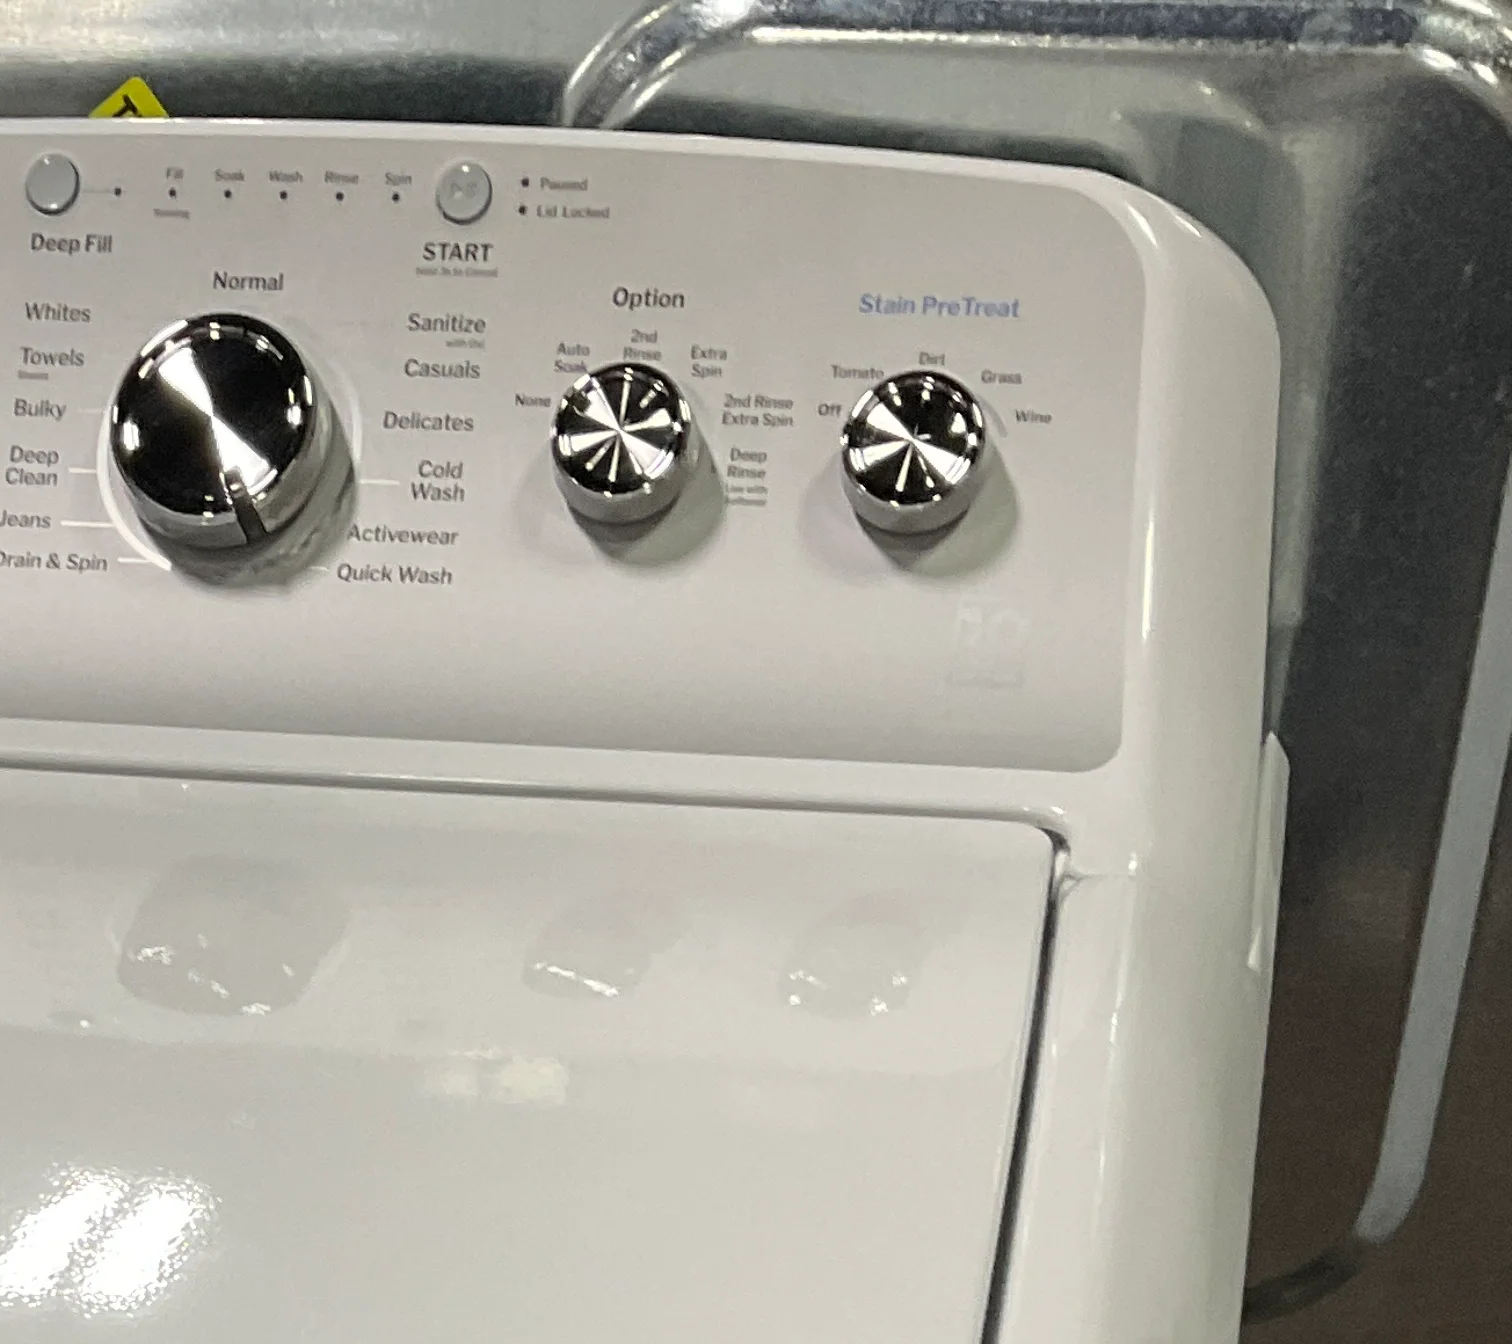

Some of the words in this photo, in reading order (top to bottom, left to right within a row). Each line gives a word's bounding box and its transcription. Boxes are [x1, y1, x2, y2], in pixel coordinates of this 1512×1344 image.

[30, 232, 81, 255] Deep
[85, 234, 113, 254] Fill
[422, 241, 494, 262] START
[212, 271, 285, 291] Normal
[611, 286, 686, 311] Option
[858, 293, 916, 315] Stain
[24, 301, 92, 323] Whites
[406, 312, 487, 334] Sanitize
[630, 328, 658, 344] 2nd
[19, 346, 85, 367] Towels
[556, 342, 590, 357] Auto
[690, 345, 727, 361] Extra
[403, 358, 481, 379] Casuals
[691, 363, 722, 379] Spin
[831, 364, 886, 381] Tomato
[13, 398, 67, 422] Bulky
[723, 392, 751, 409] 2nd
[754, 394, 794, 410] Rinse
[817, 402, 842, 417] Off
[382, 410, 475, 432] Delicates
[721, 410, 759, 426] Extra
[762, 412, 794, 428] Spin
[9, 444, 60, 468] Deep
[4, 467, 59, 486] Clean
[418, 459, 464, 480] Cold
[410, 481, 466, 503] Wash
[346, 523, 459, 546] Activewear
[45, 552, 61, 571] &
[65, 552, 108, 574] Spin
[336, 562, 393, 583] Quick
[398, 564, 454, 585] Wash
